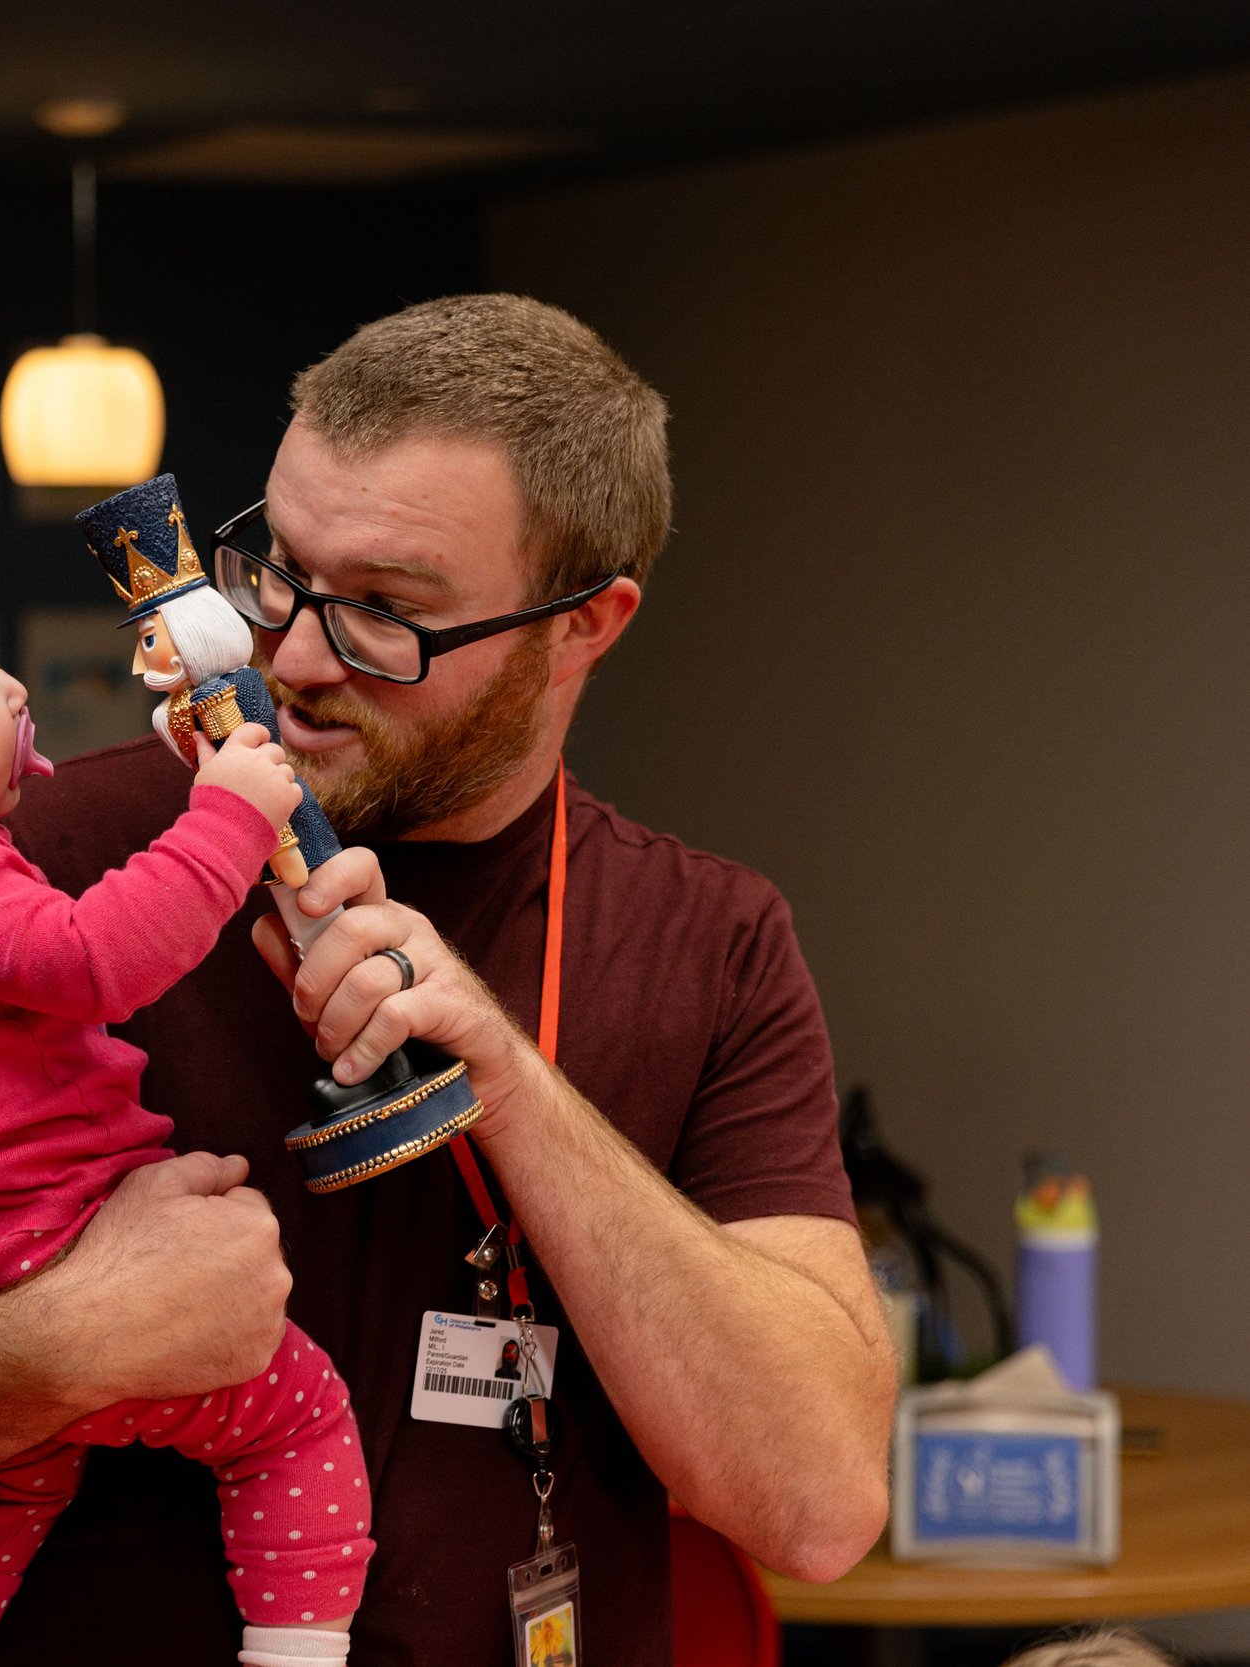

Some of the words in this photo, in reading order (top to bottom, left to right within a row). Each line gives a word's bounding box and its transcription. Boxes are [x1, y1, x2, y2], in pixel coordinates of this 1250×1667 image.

[455, 1324, 482, 1332] Philadelphia
[427, 1351, 468, 1361] Parent/Guardian
[426, 1358, 452, 1367] Expiration
